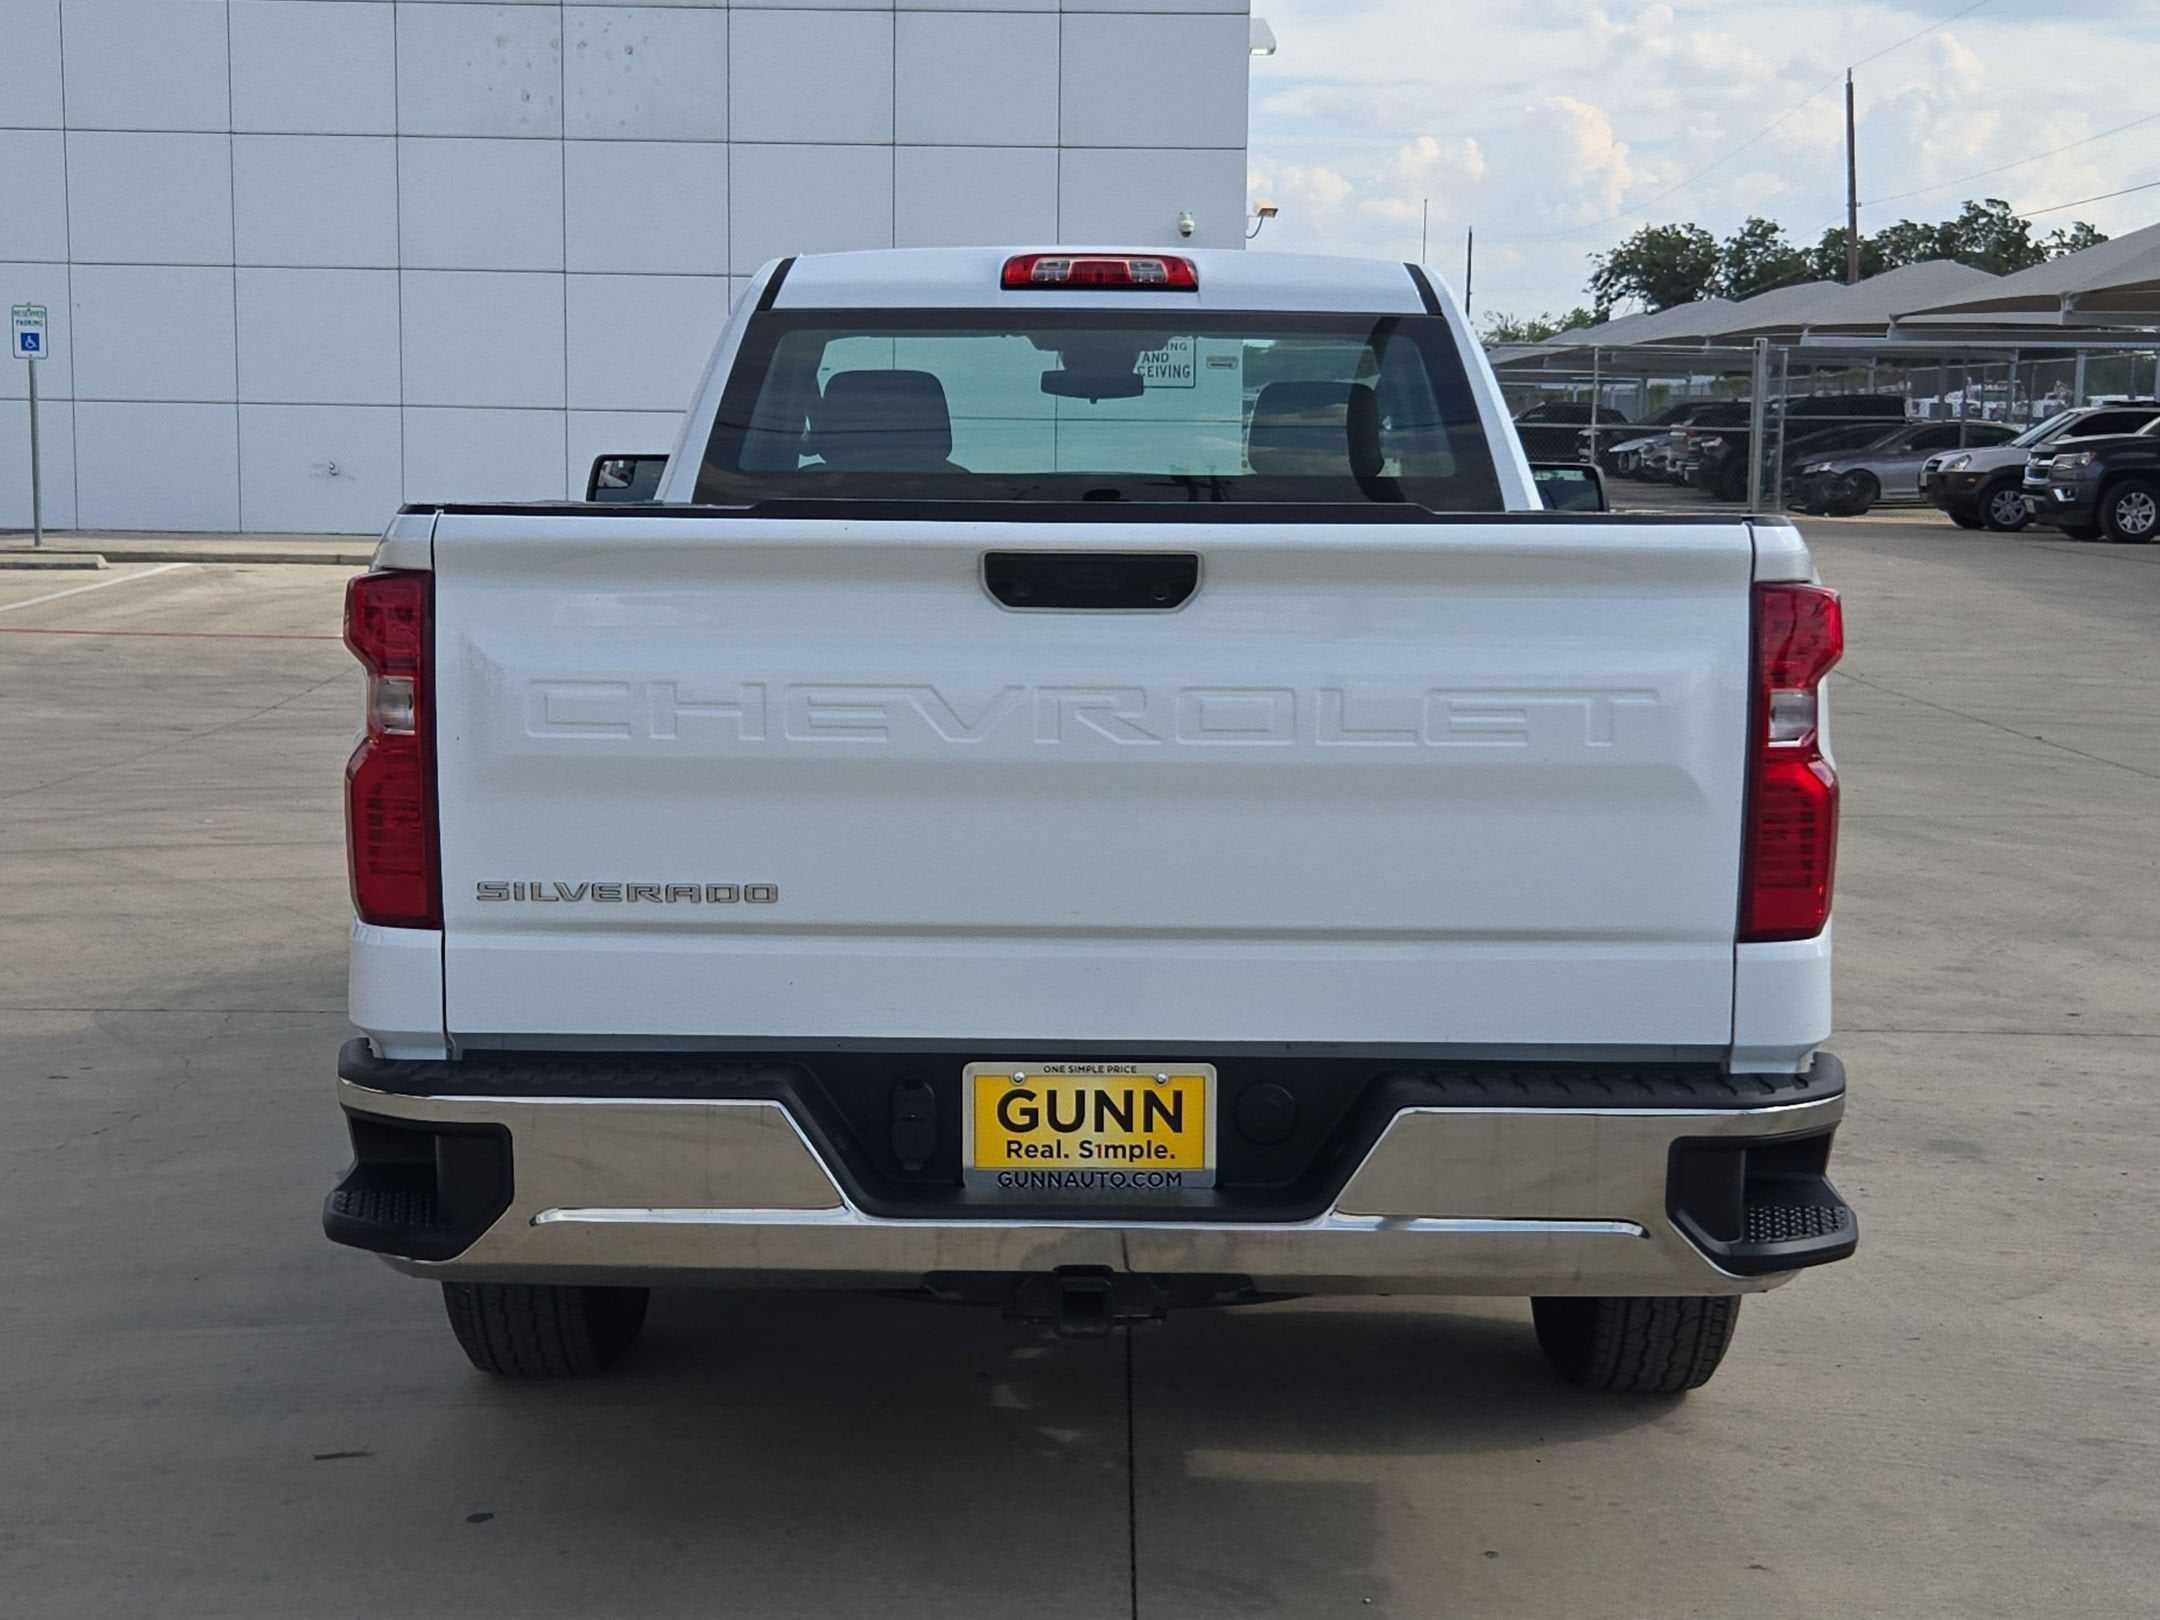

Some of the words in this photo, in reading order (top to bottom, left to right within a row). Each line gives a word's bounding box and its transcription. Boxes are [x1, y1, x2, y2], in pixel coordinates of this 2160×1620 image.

[1141, 352, 1169, 364] AND
[1137, 365, 1190, 378] CEIVING
[525, 680, 1660, 748] CHEVROLET
[476, 881, 780, 904] SILVERADO
[1043, 1065, 1065, 1074] ONE
[1068, 1065, 1104, 1074] SIMPLE
[1107, 1065, 1137, 1074] PRICE
[997, 1088, 1182, 1133] GUNN
[1006, 1139, 1069, 1159] Real.
[997, 1170, 1182, 1188] GUNNAUTO.COM
